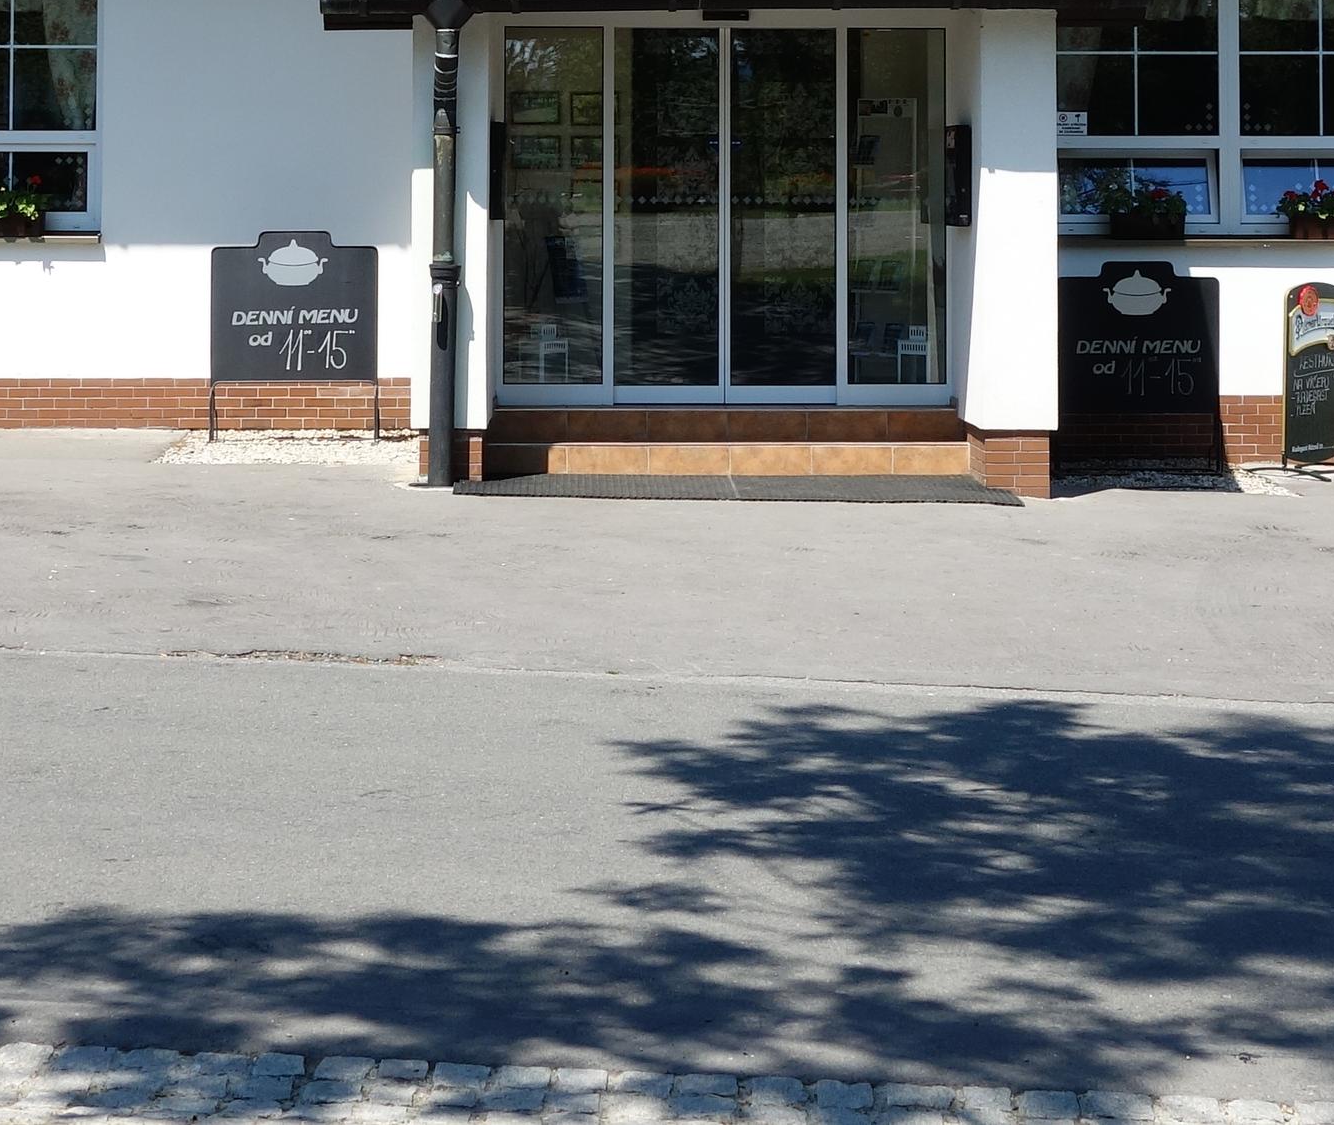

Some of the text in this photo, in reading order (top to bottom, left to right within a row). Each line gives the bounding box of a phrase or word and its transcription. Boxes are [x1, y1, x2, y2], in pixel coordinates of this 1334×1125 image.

[231, 306, 359, 326] DENNÍ MENU
[248, 331, 273, 346] od
[1076, 336, 1201, 354] DENNÍ MENU
[1092, 360, 1116, 375] od
